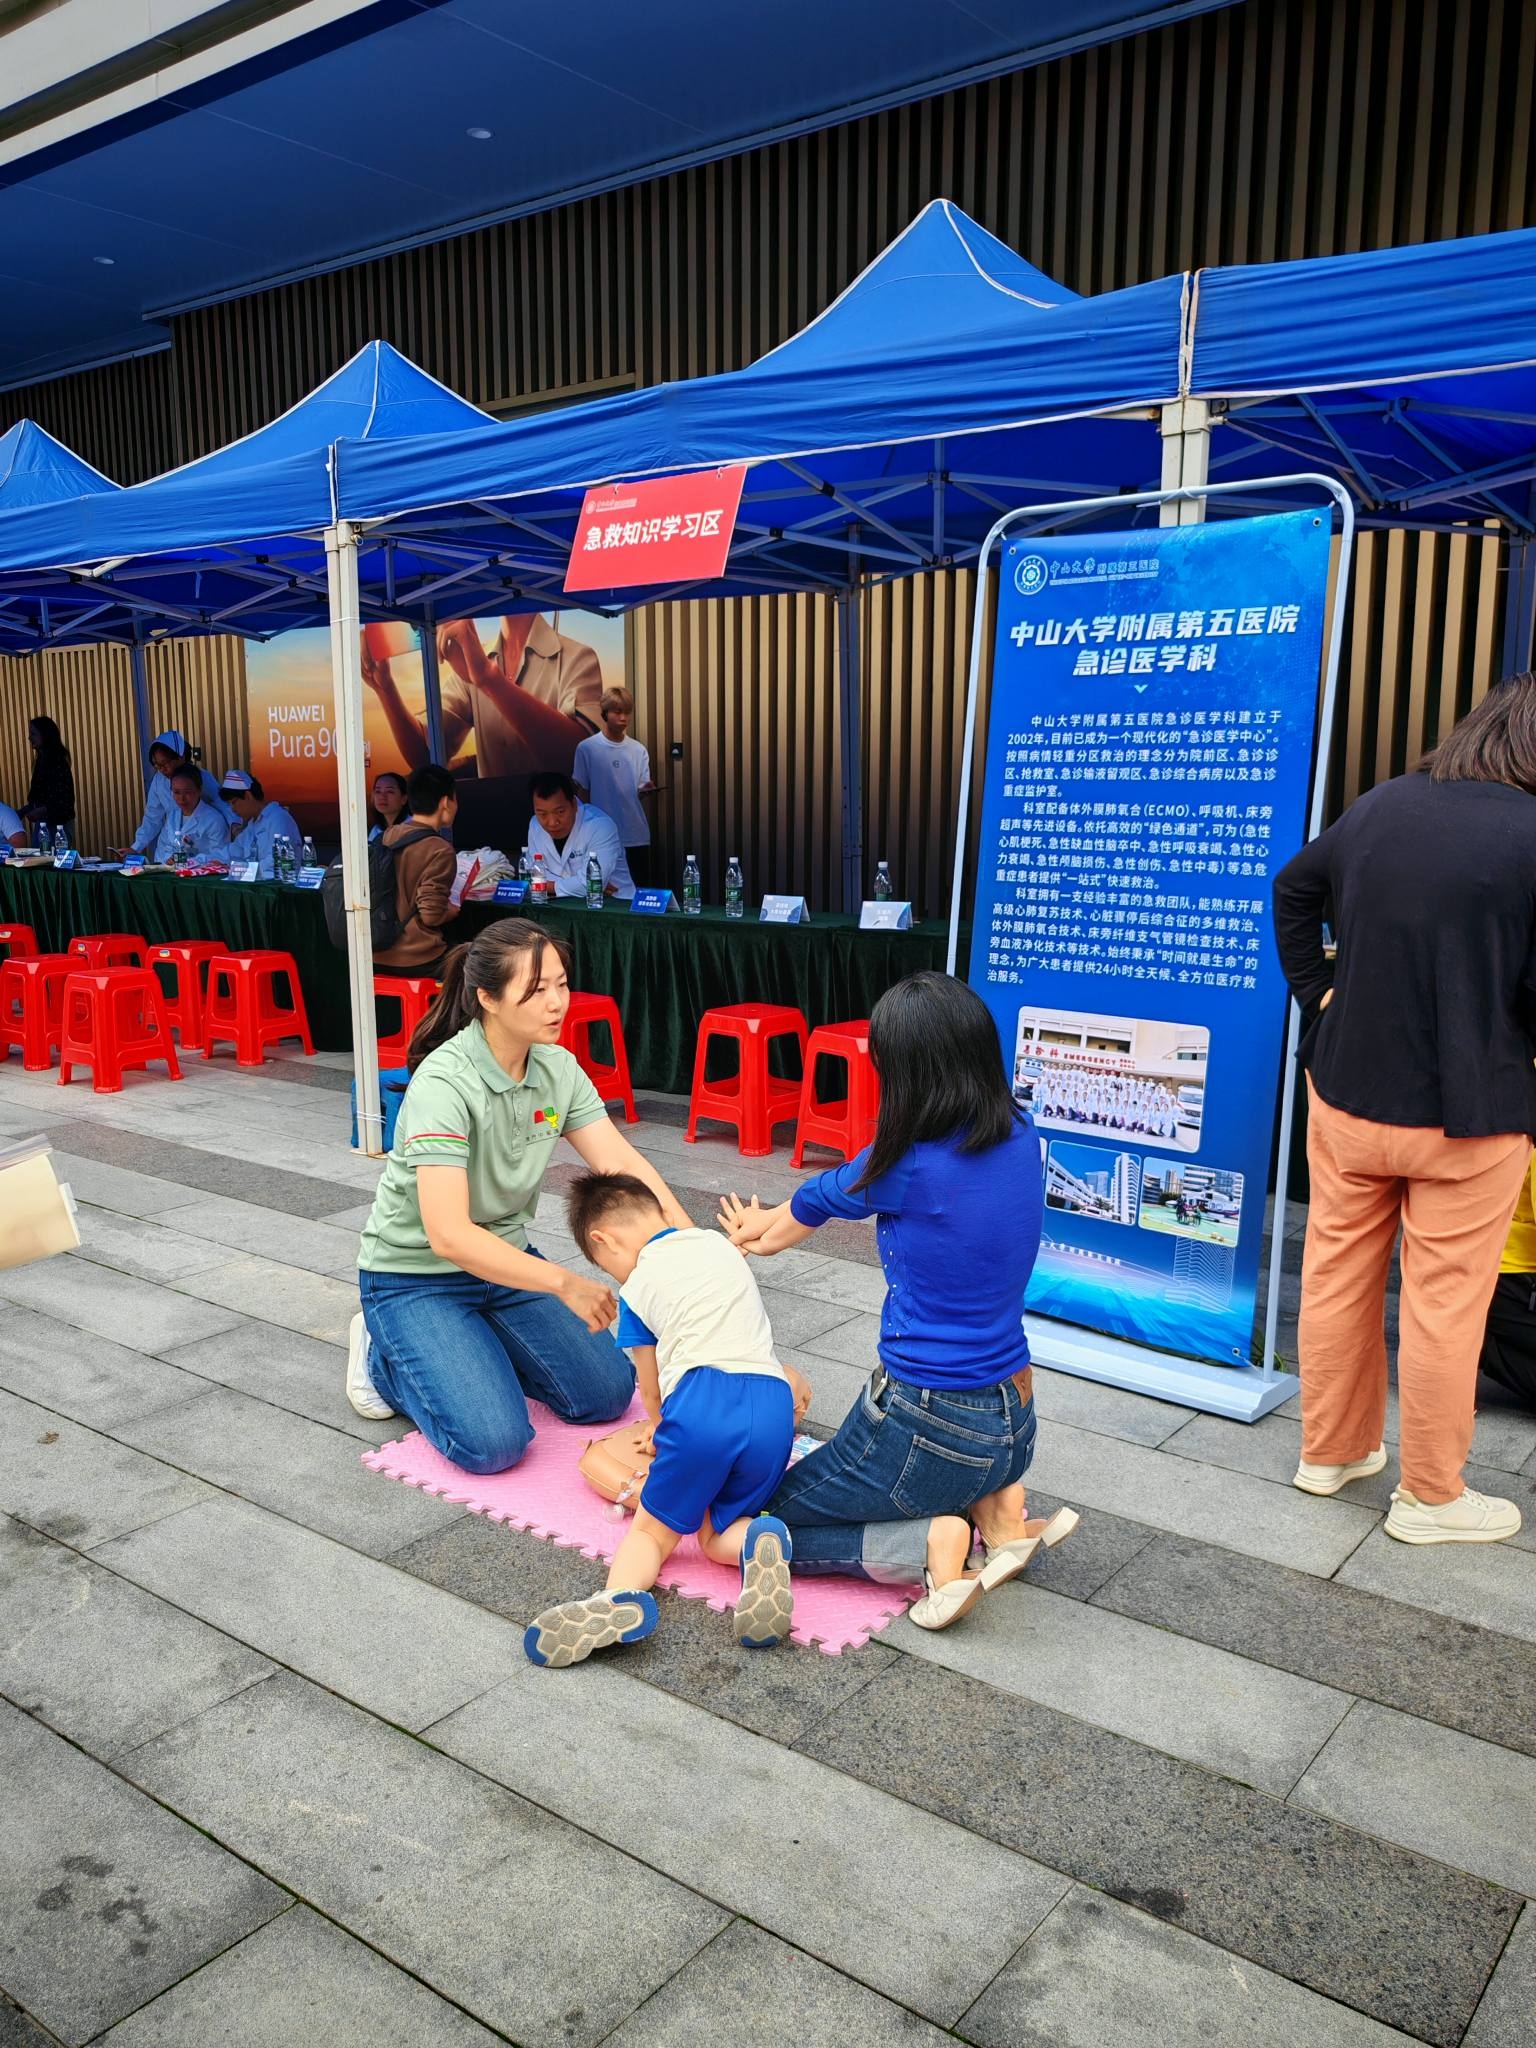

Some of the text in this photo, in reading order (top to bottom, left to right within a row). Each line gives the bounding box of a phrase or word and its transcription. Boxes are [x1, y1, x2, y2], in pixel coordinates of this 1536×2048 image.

[583, 510, 723, 551] 急救知识学习区
[1010, 605, 1300, 647] 中山大学附属第五医院
[1072, 643, 1217, 676] 急诊医学科
[268, 704, 325, 723] HUAWEI
[1031, 710, 1282, 728] 中山大学附属第五医院急诊医学科建立于
[1003, 784, 1063, 798] 重症监护室。
[987, 969, 1024, 984] 治服务。
